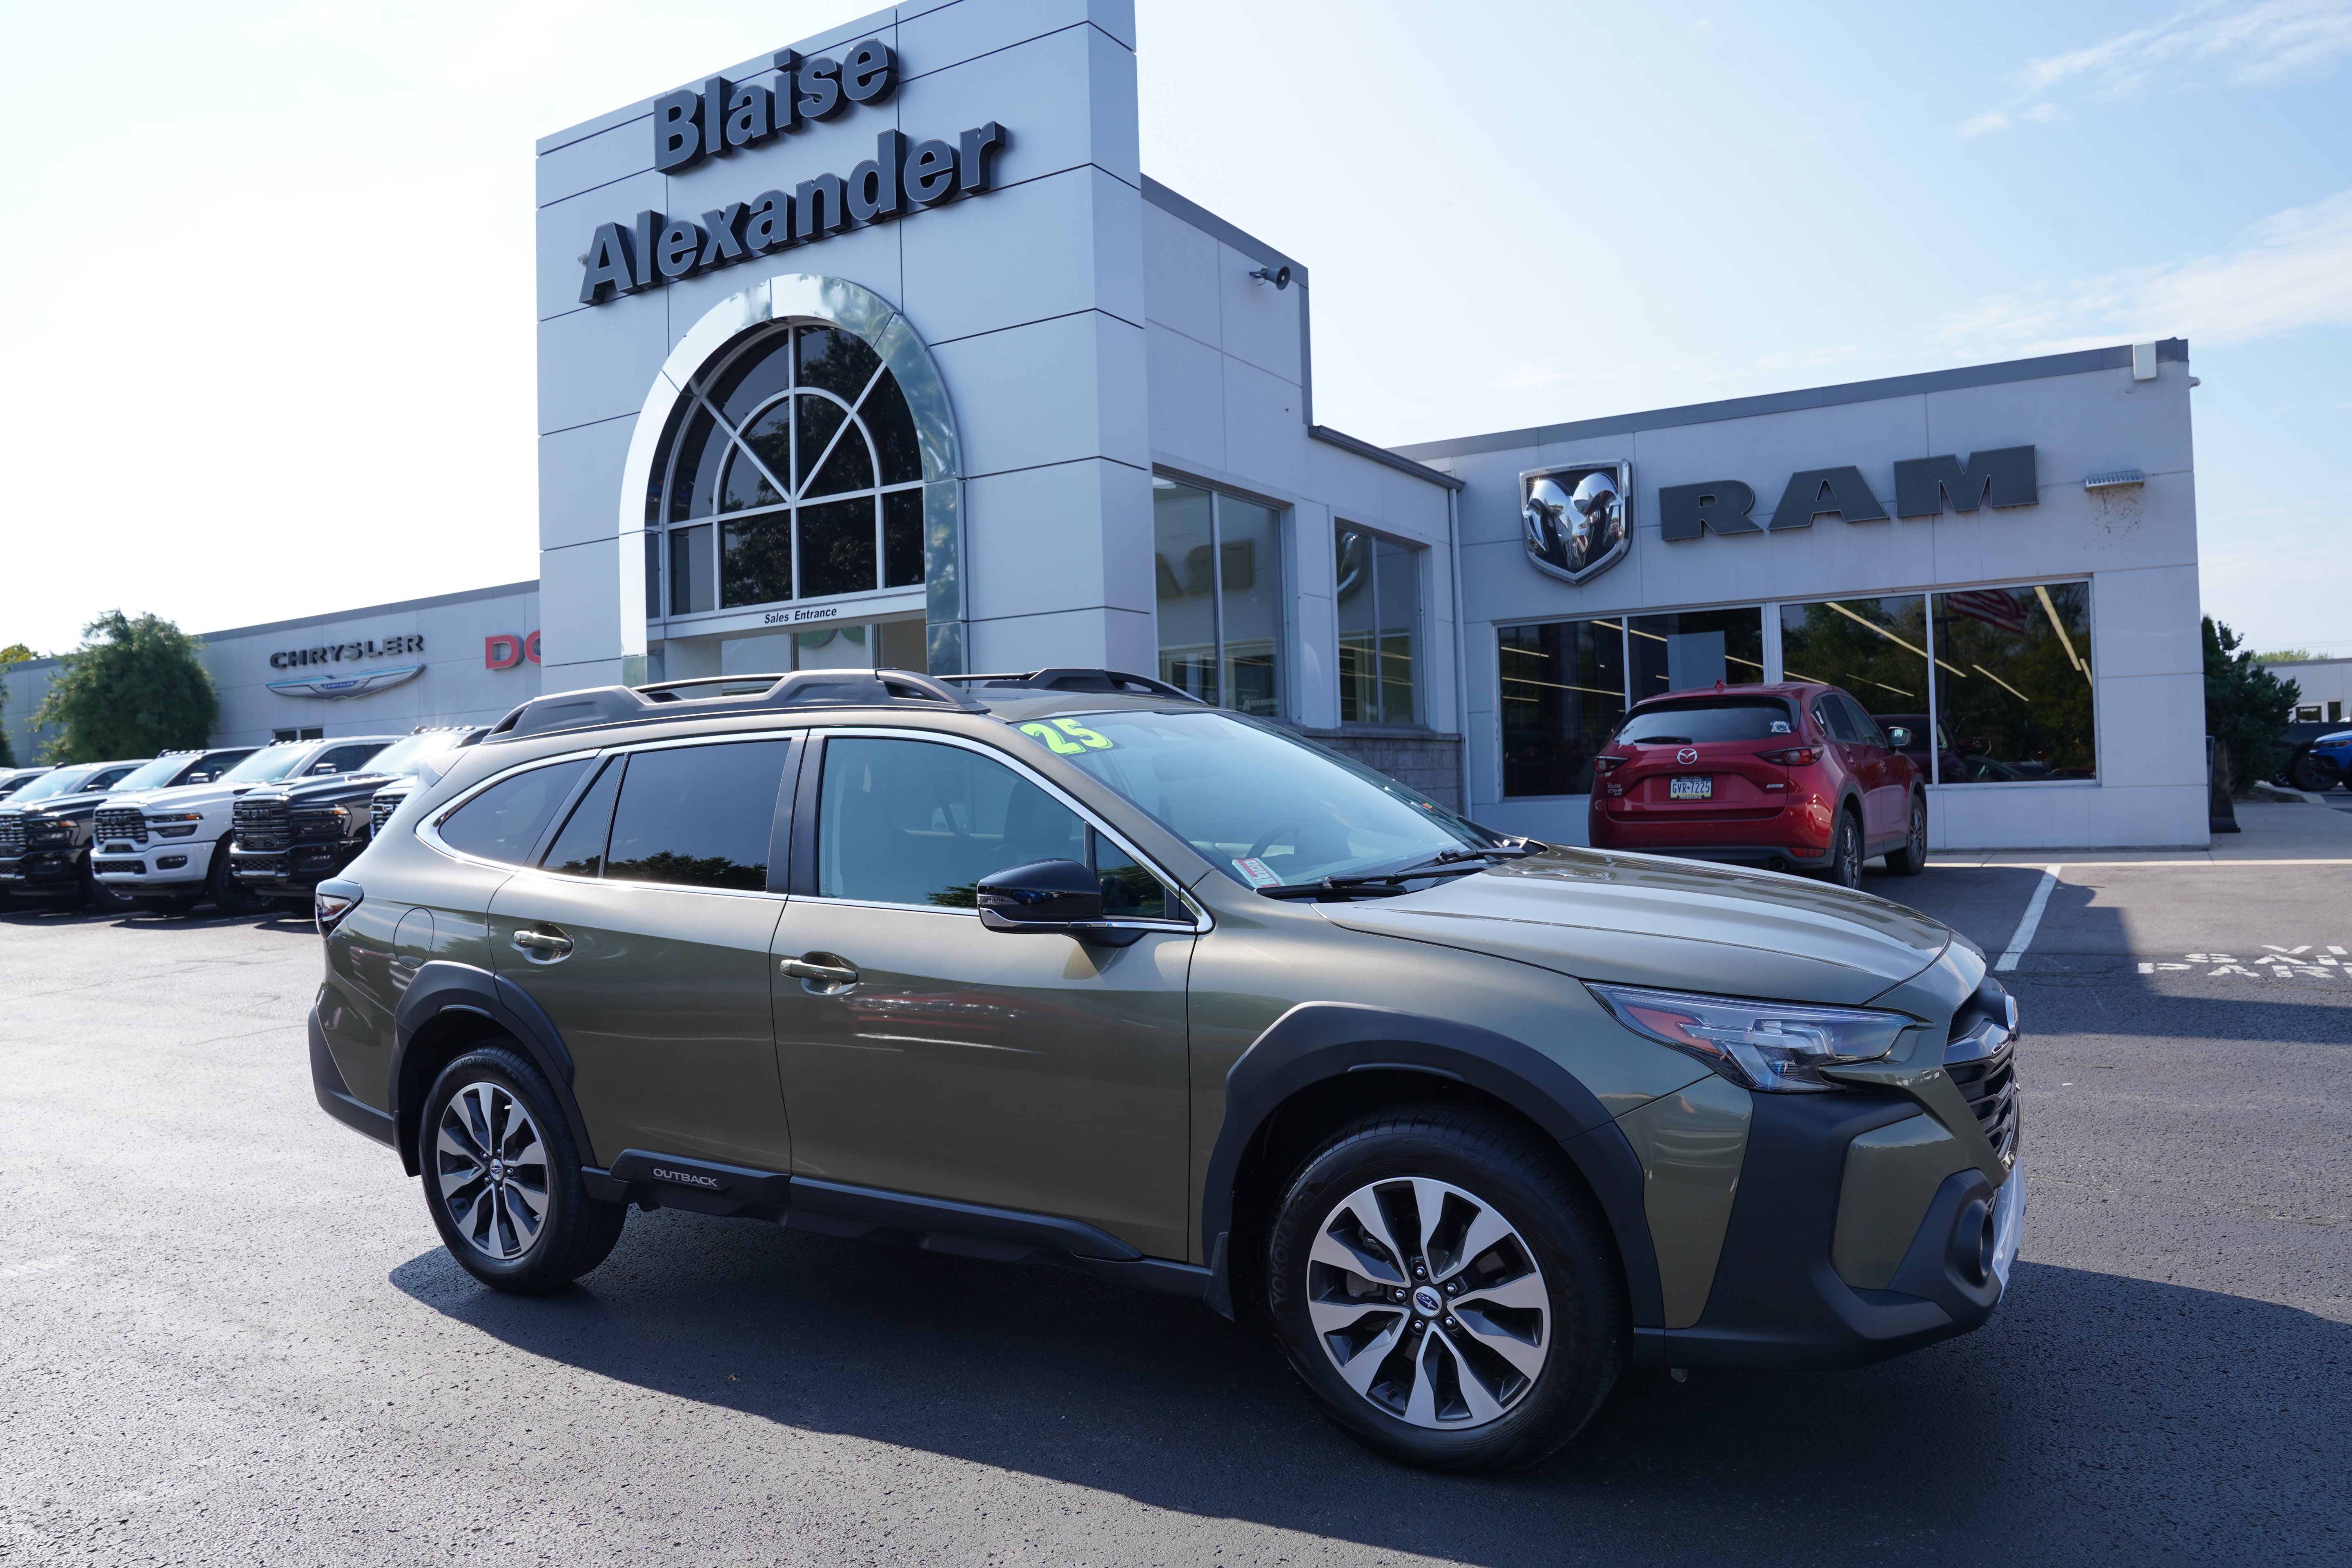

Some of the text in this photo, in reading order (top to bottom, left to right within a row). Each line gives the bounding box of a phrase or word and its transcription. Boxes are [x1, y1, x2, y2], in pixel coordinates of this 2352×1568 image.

[654, 38, 898, 174] Blaise
[579, 120, 1006, 305] Alexander
[1658, 445, 2039, 541] RAM
[765, 608, 837, 624] Sales Entrance
[270, 635, 424, 669] CHRYSLER
[1019, 718, 1113, 754] 25
[653, 1168, 718, 1187] OUTBACK
[1271, 1189, 1314, 1305] YOKOHAMA
